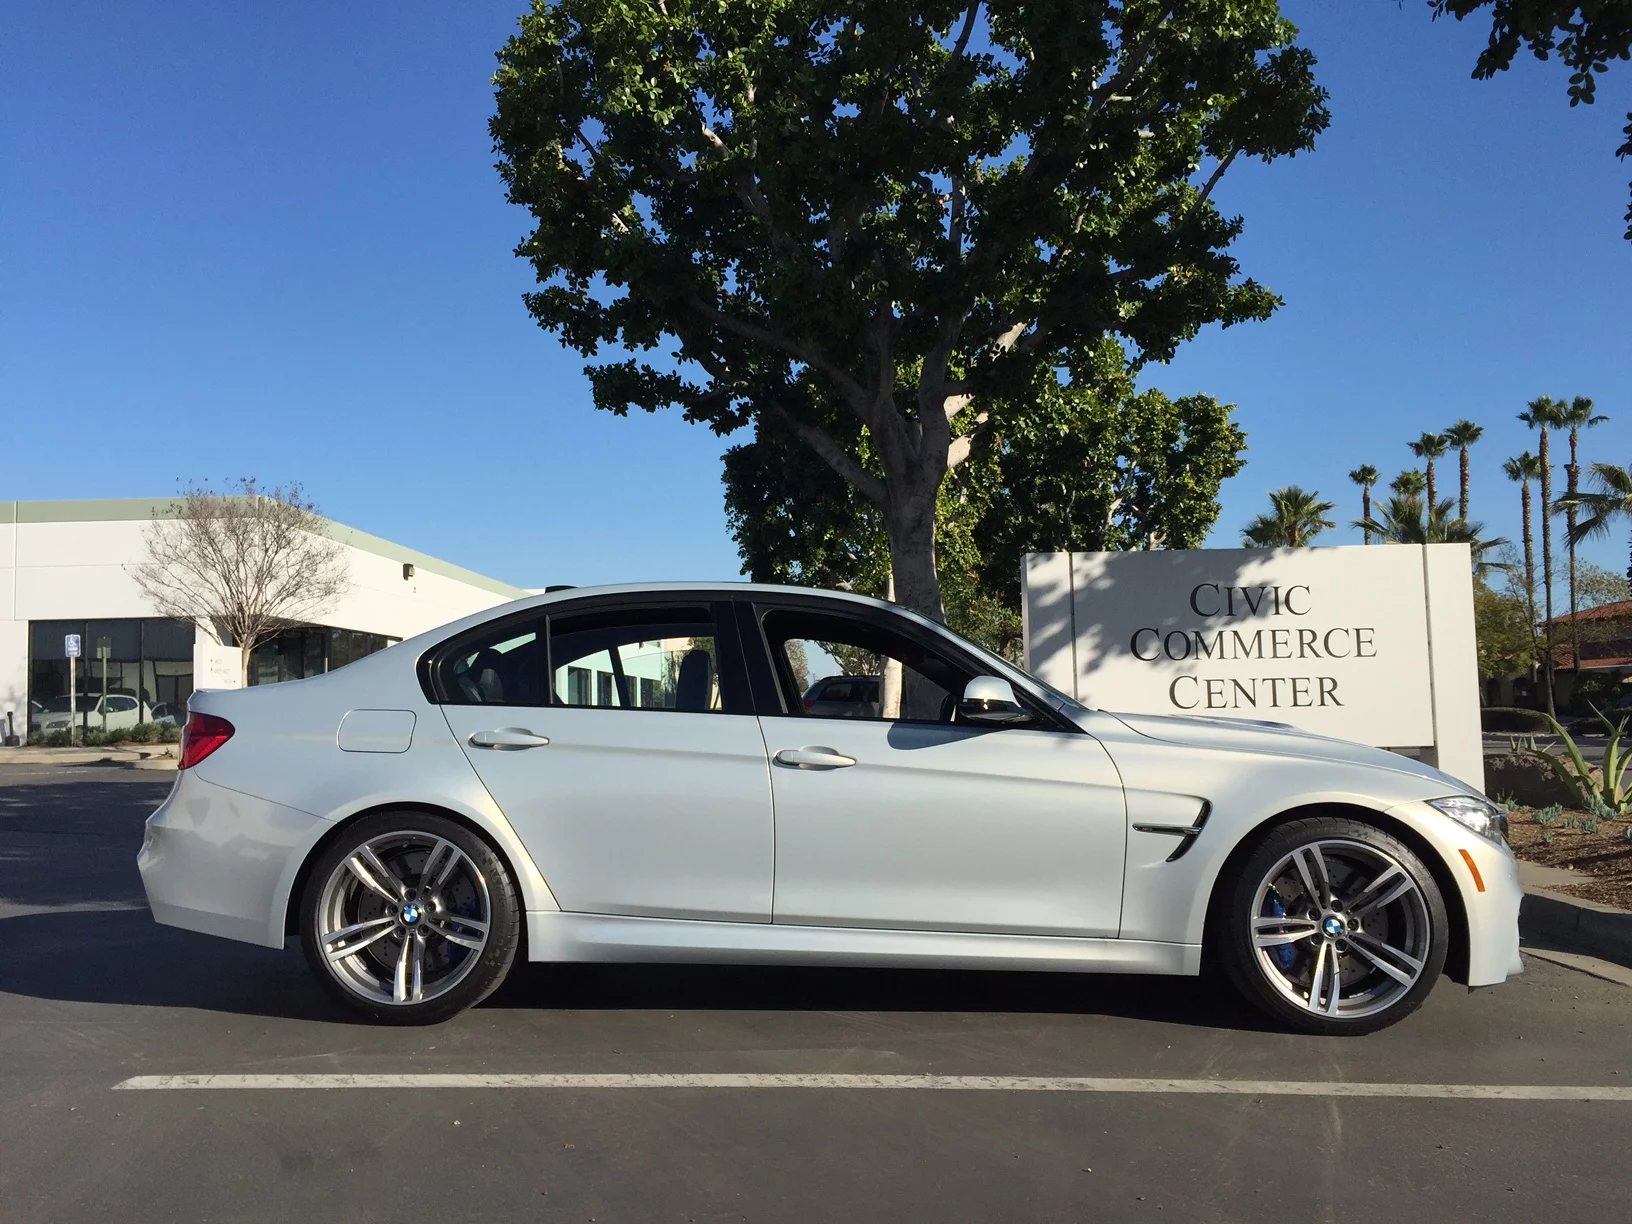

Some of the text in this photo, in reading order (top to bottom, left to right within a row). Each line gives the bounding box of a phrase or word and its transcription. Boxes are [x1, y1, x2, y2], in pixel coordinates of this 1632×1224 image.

[1190, 583, 1312, 617] CIVIC
[1130, 627, 1378, 662] COMMERCE
[1168, 675, 1346, 710] CENTER
